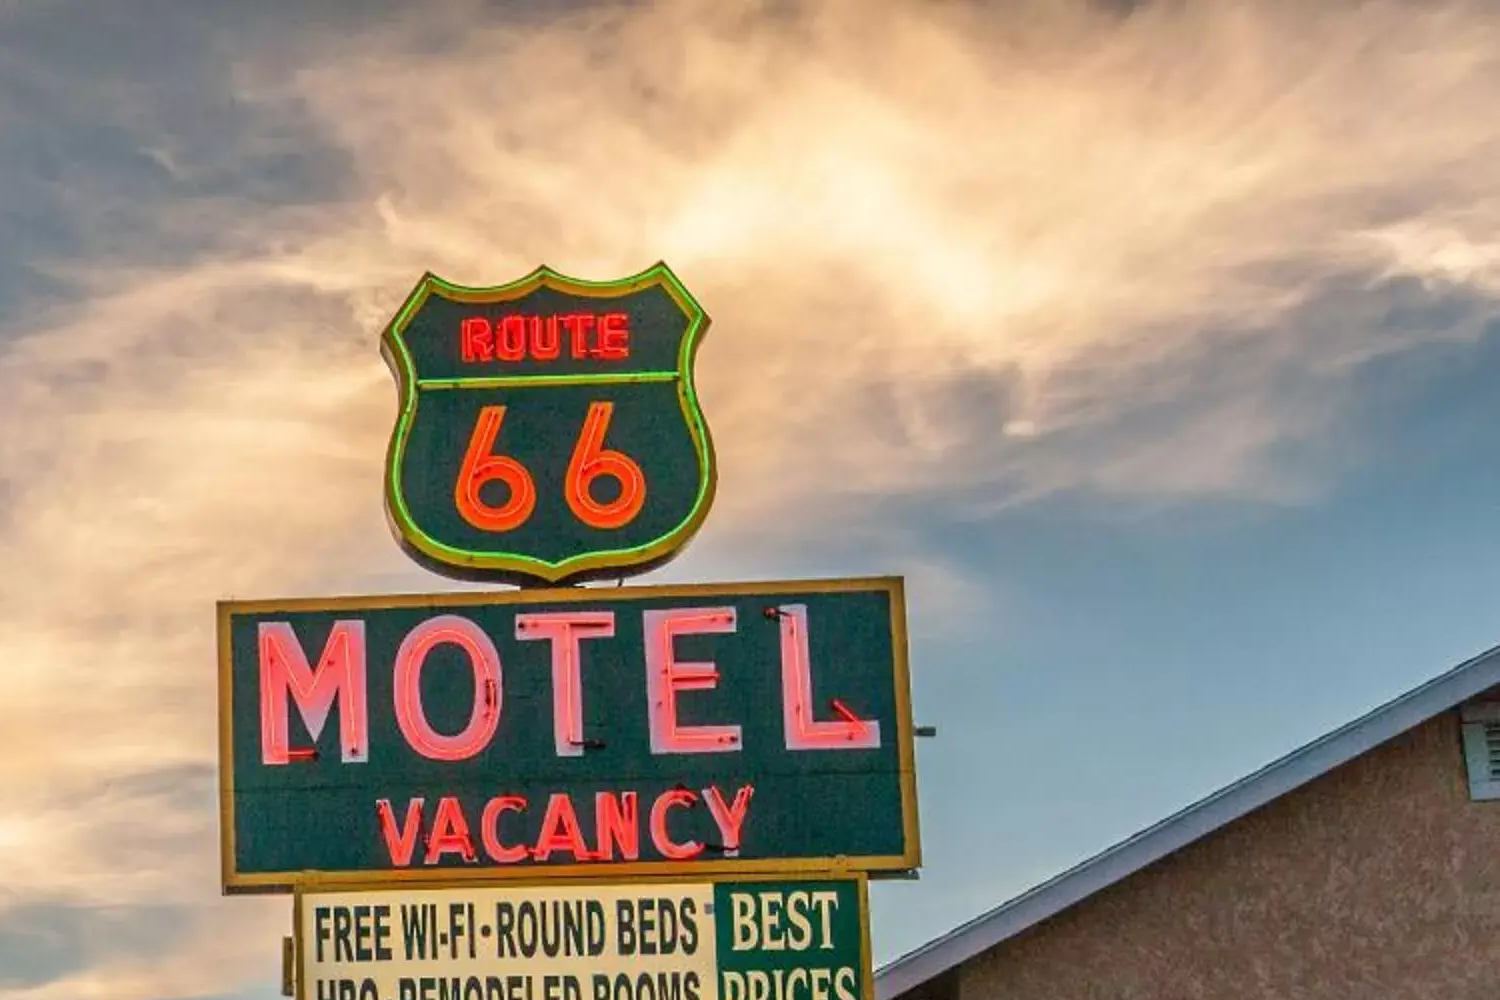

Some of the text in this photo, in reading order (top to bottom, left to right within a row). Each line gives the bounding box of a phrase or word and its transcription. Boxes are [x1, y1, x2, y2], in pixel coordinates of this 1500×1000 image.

[461, 311, 629, 362] ROUTE
[455, 401, 646, 532] 66
[258, 604, 881, 765] MOTEL
[376, 784, 754, 866] VACANCY
[315, 904, 393, 963] FREE
[616, 897, 698, 955] BEDS
[729, 891, 839, 951] BEST
